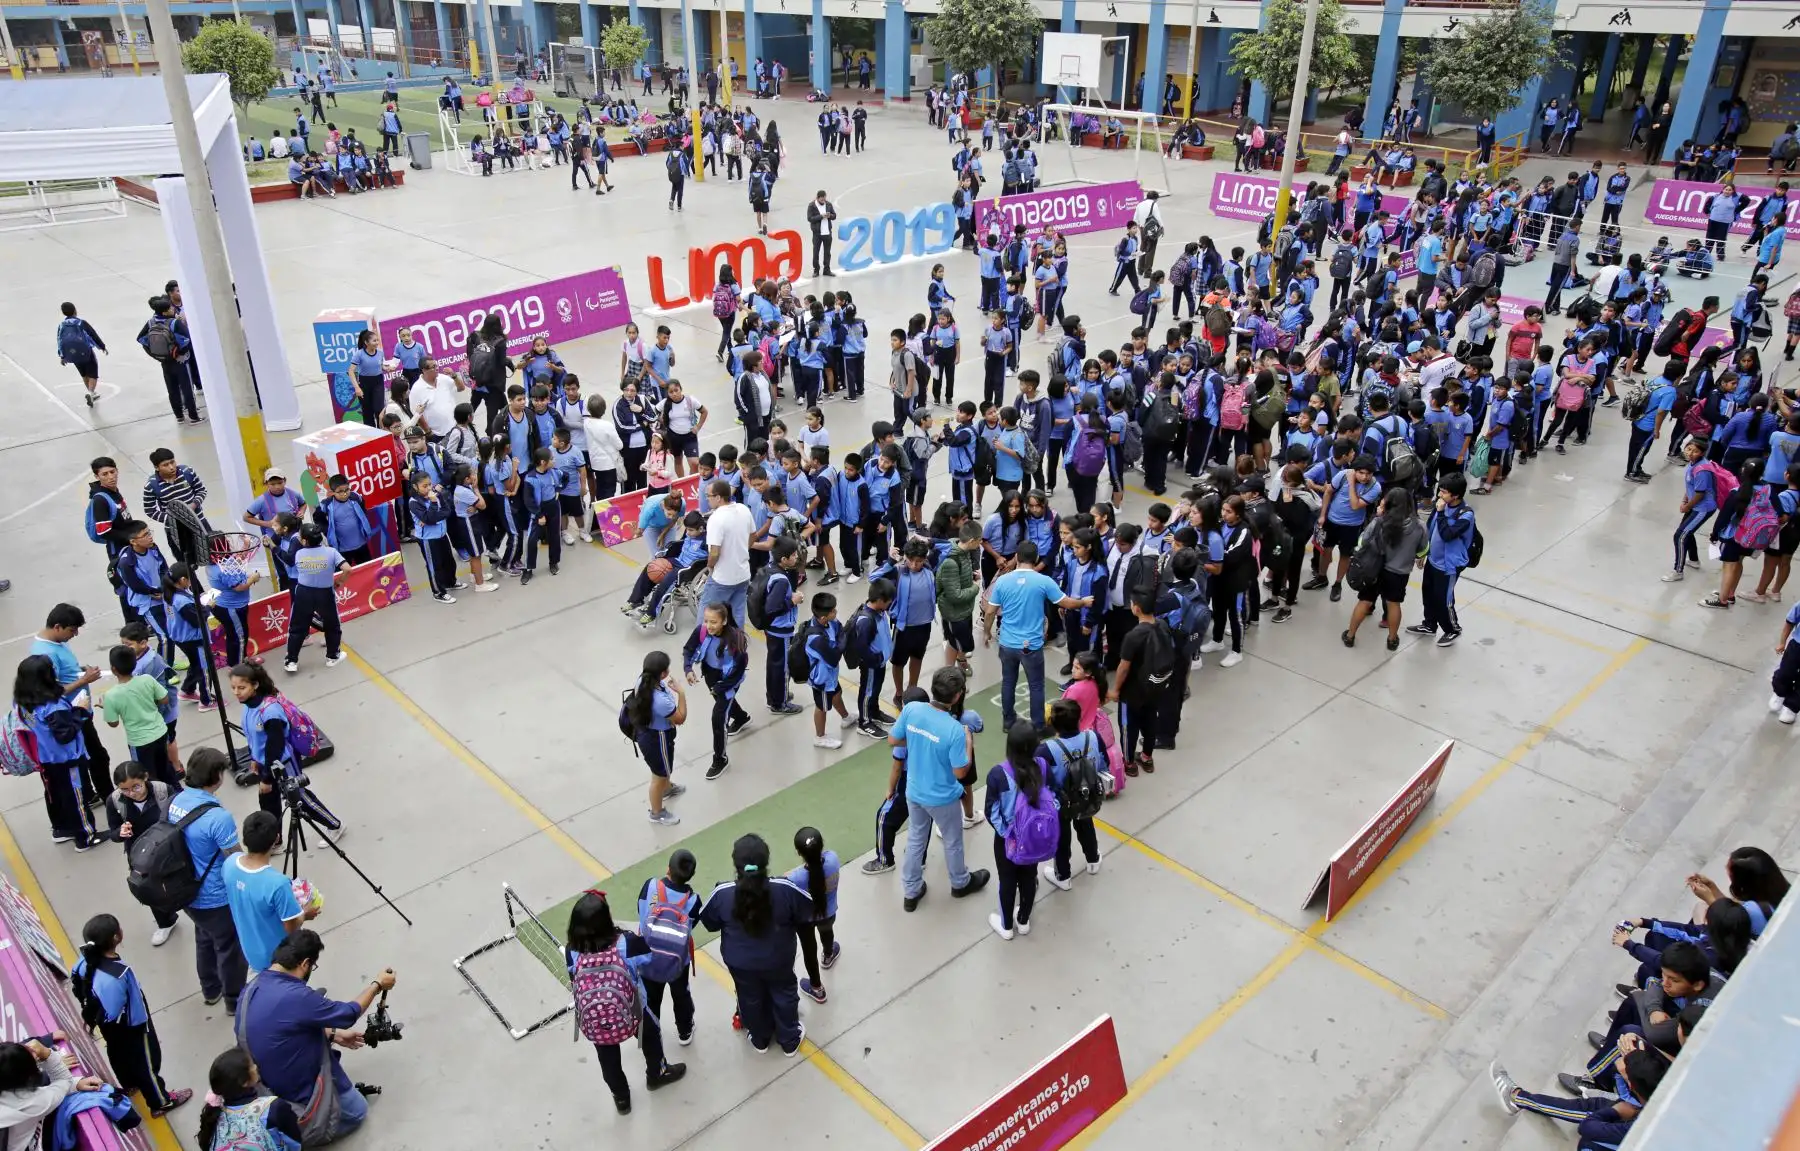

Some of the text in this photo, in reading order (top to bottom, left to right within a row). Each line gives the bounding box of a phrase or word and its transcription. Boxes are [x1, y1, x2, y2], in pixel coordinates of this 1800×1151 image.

[838, 201, 955, 272] 2019
[320, 332, 362, 347] LIM
[348, 467, 396, 496] 2019
[1347, 812, 1406, 881] Parapanamericanos
[1406, 796, 1422, 816] Lima
[1060, 1072, 1069, 1088] y
[1027, 1074, 1090, 1132] Lima 2019
